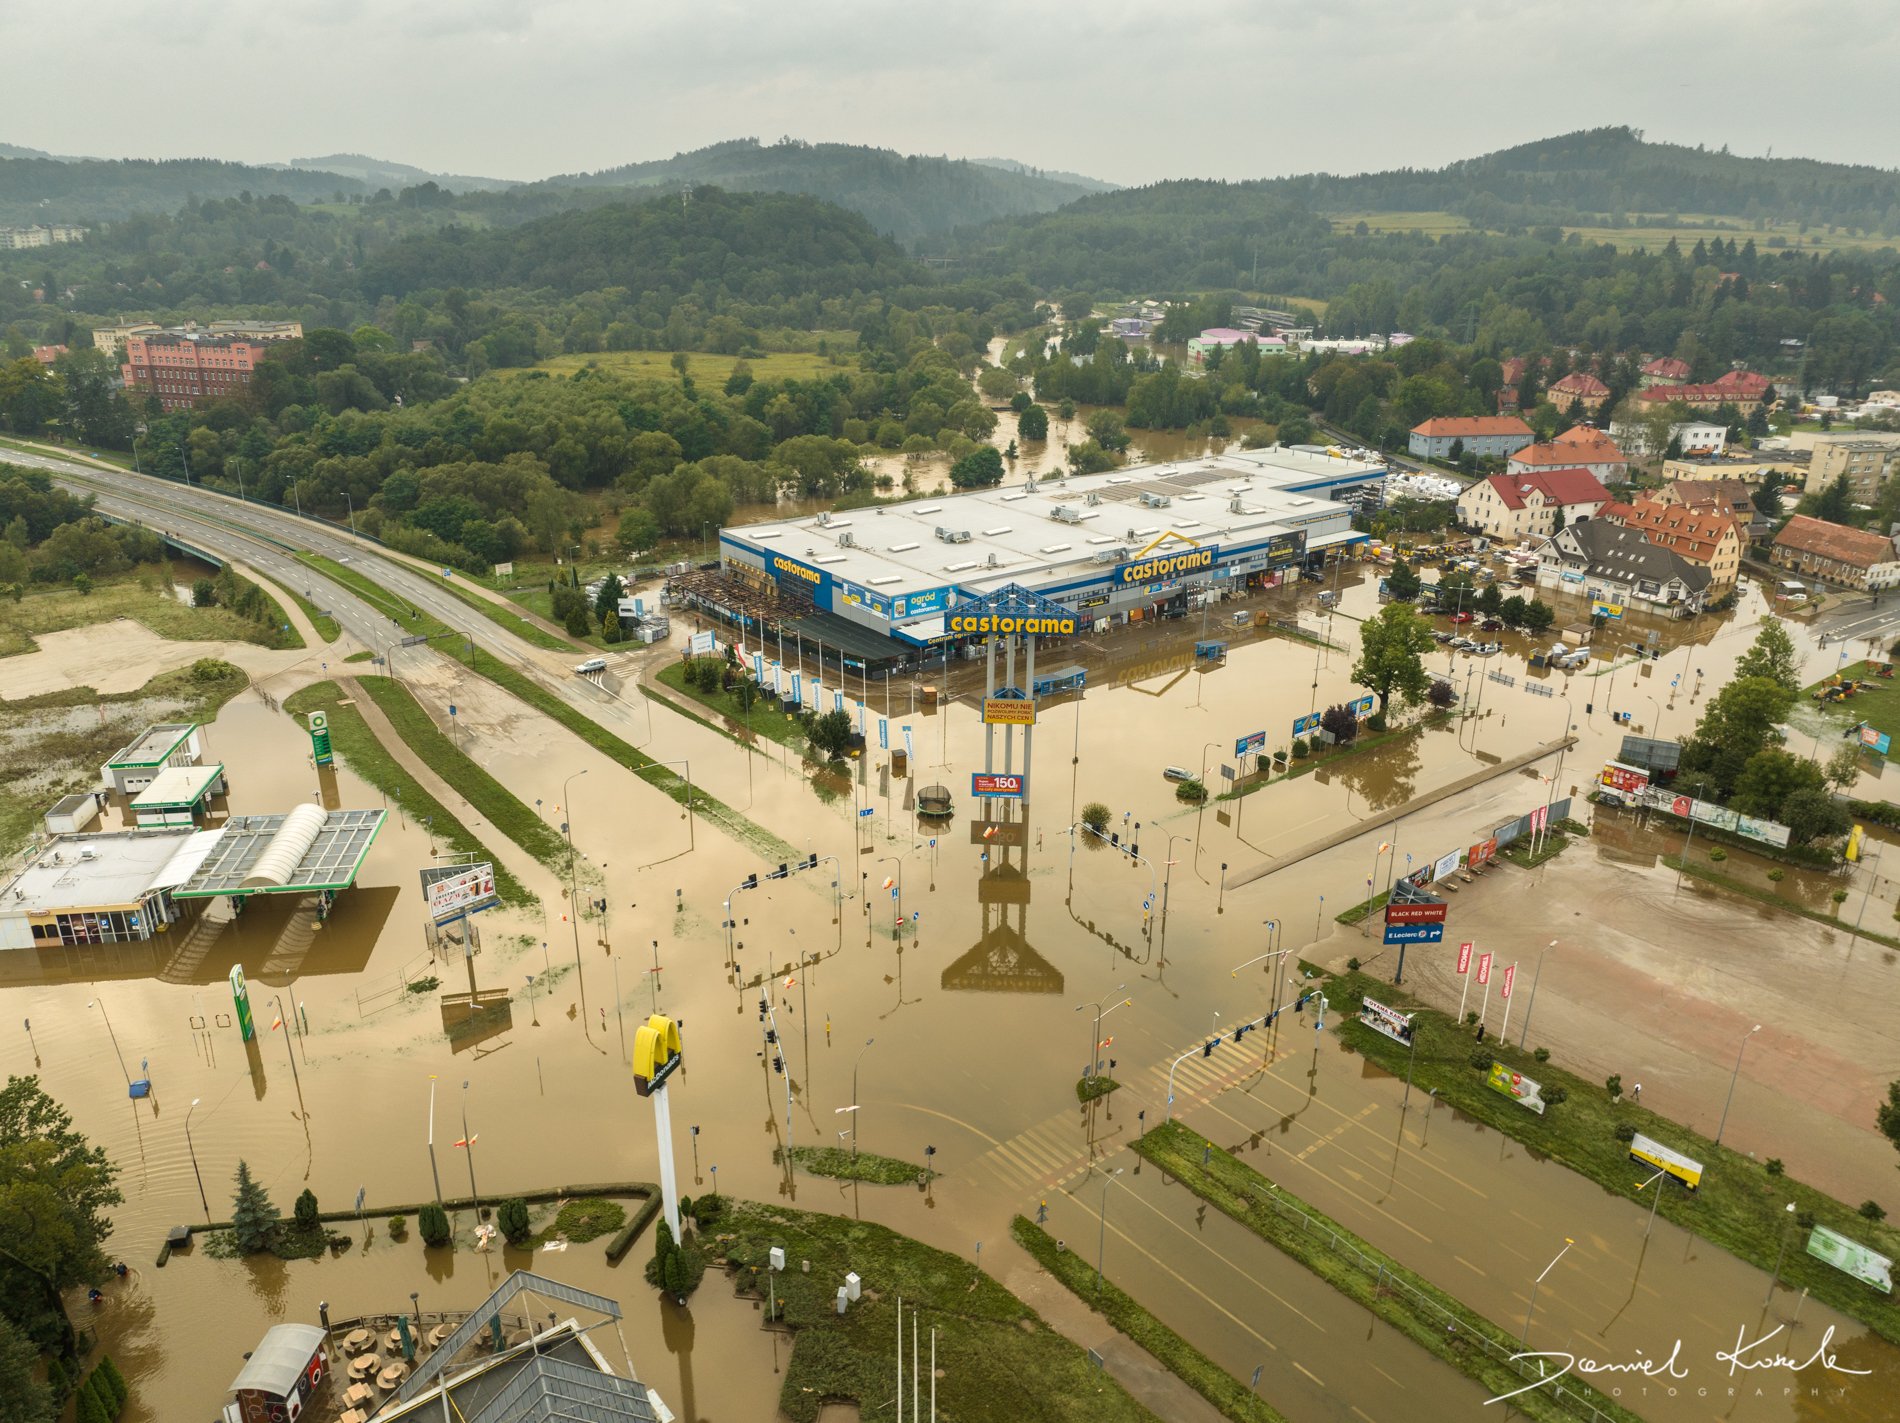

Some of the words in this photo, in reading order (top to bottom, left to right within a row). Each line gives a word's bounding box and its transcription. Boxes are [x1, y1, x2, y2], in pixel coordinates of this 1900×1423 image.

[773, 556, 821, 585] castorama
[1123, 550, 1212, 583] castorama
[911, 592, 936, 606] ogród
[951, 614, 1074, 634] castorama
[987, 702, 1018, 710] NIKOMU
[994, 777, 1016, 789] 150
[1369, 1000, 1388, 1014] OYAMA
